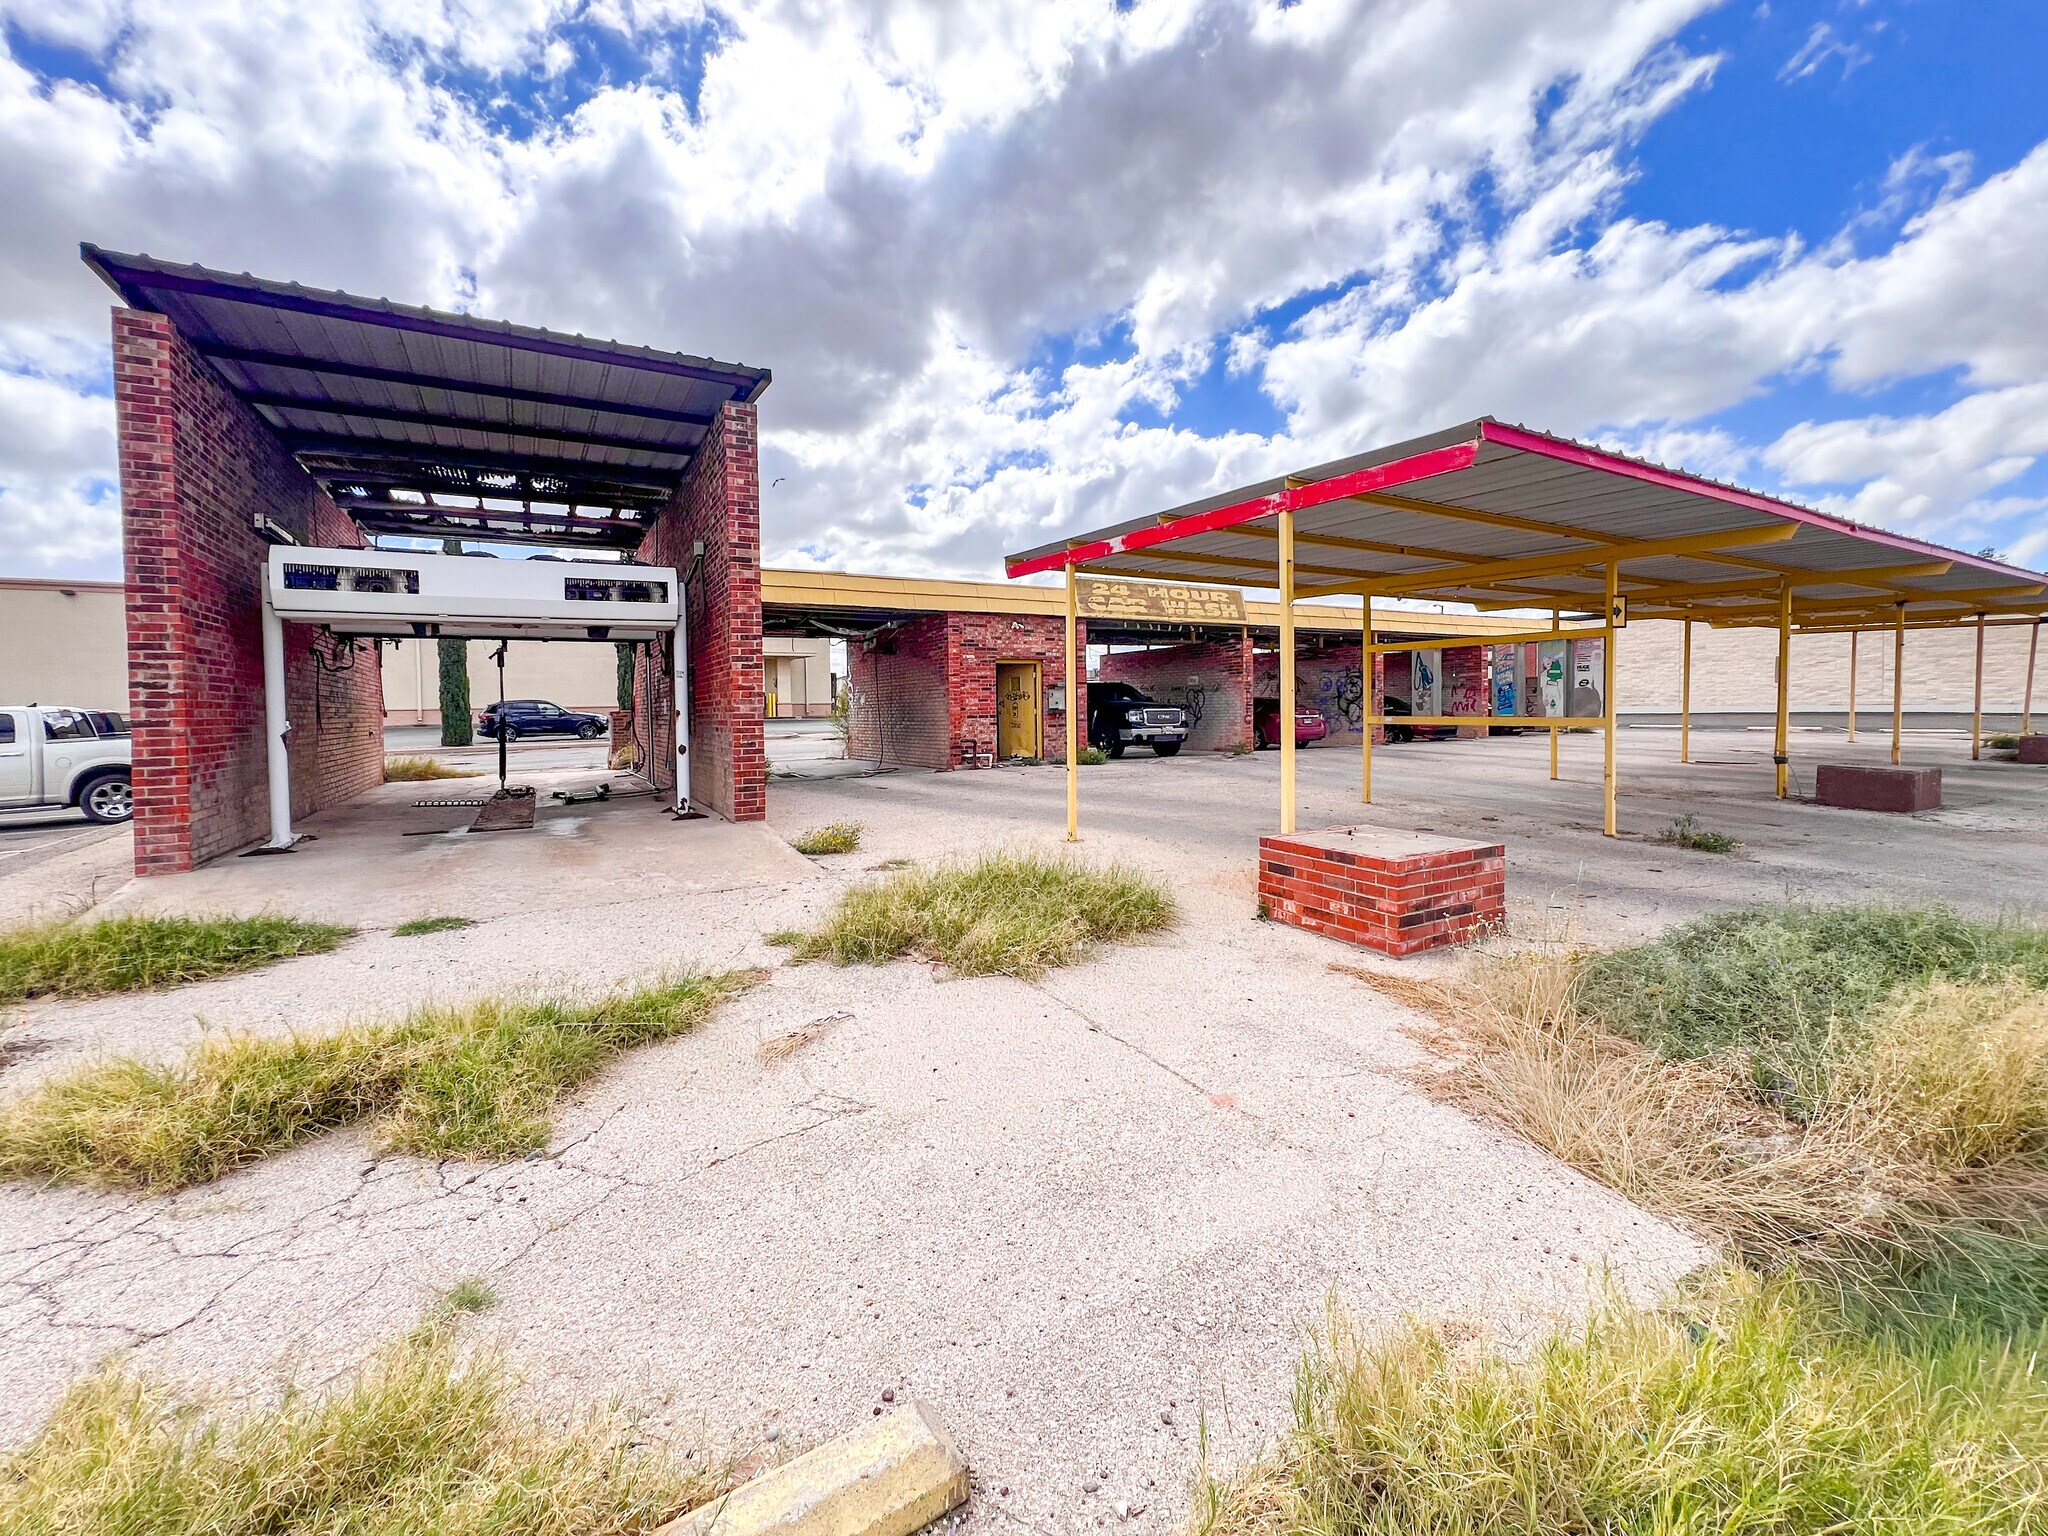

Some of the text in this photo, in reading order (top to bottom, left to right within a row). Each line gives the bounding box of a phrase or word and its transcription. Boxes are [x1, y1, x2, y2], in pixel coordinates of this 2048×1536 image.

[1091, 583, 1230, 602] 24 HOUR
[1088, 596, 1239, 618] CAR WASH
